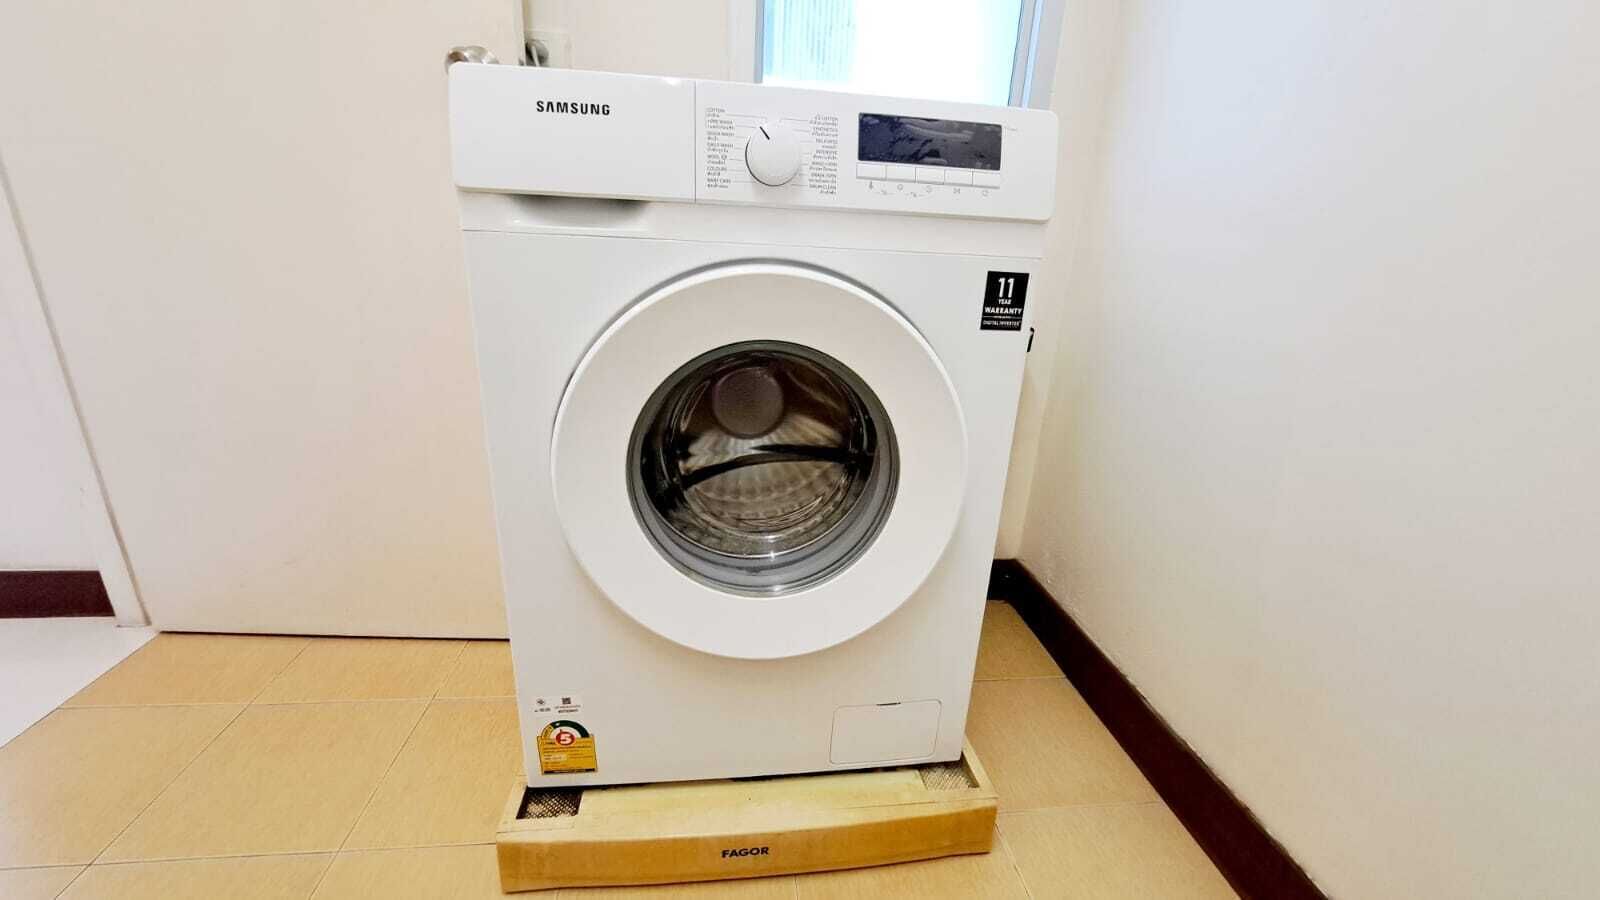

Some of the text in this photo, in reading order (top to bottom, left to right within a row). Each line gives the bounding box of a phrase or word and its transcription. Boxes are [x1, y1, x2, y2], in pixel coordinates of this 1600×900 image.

[536, 100, 610, 116] SAMSUNG
[998, 277, 1014, 298] 11
[984, 306, 1022, 314] WARRANTY
[721, 846, 769, 859] FAGOR
